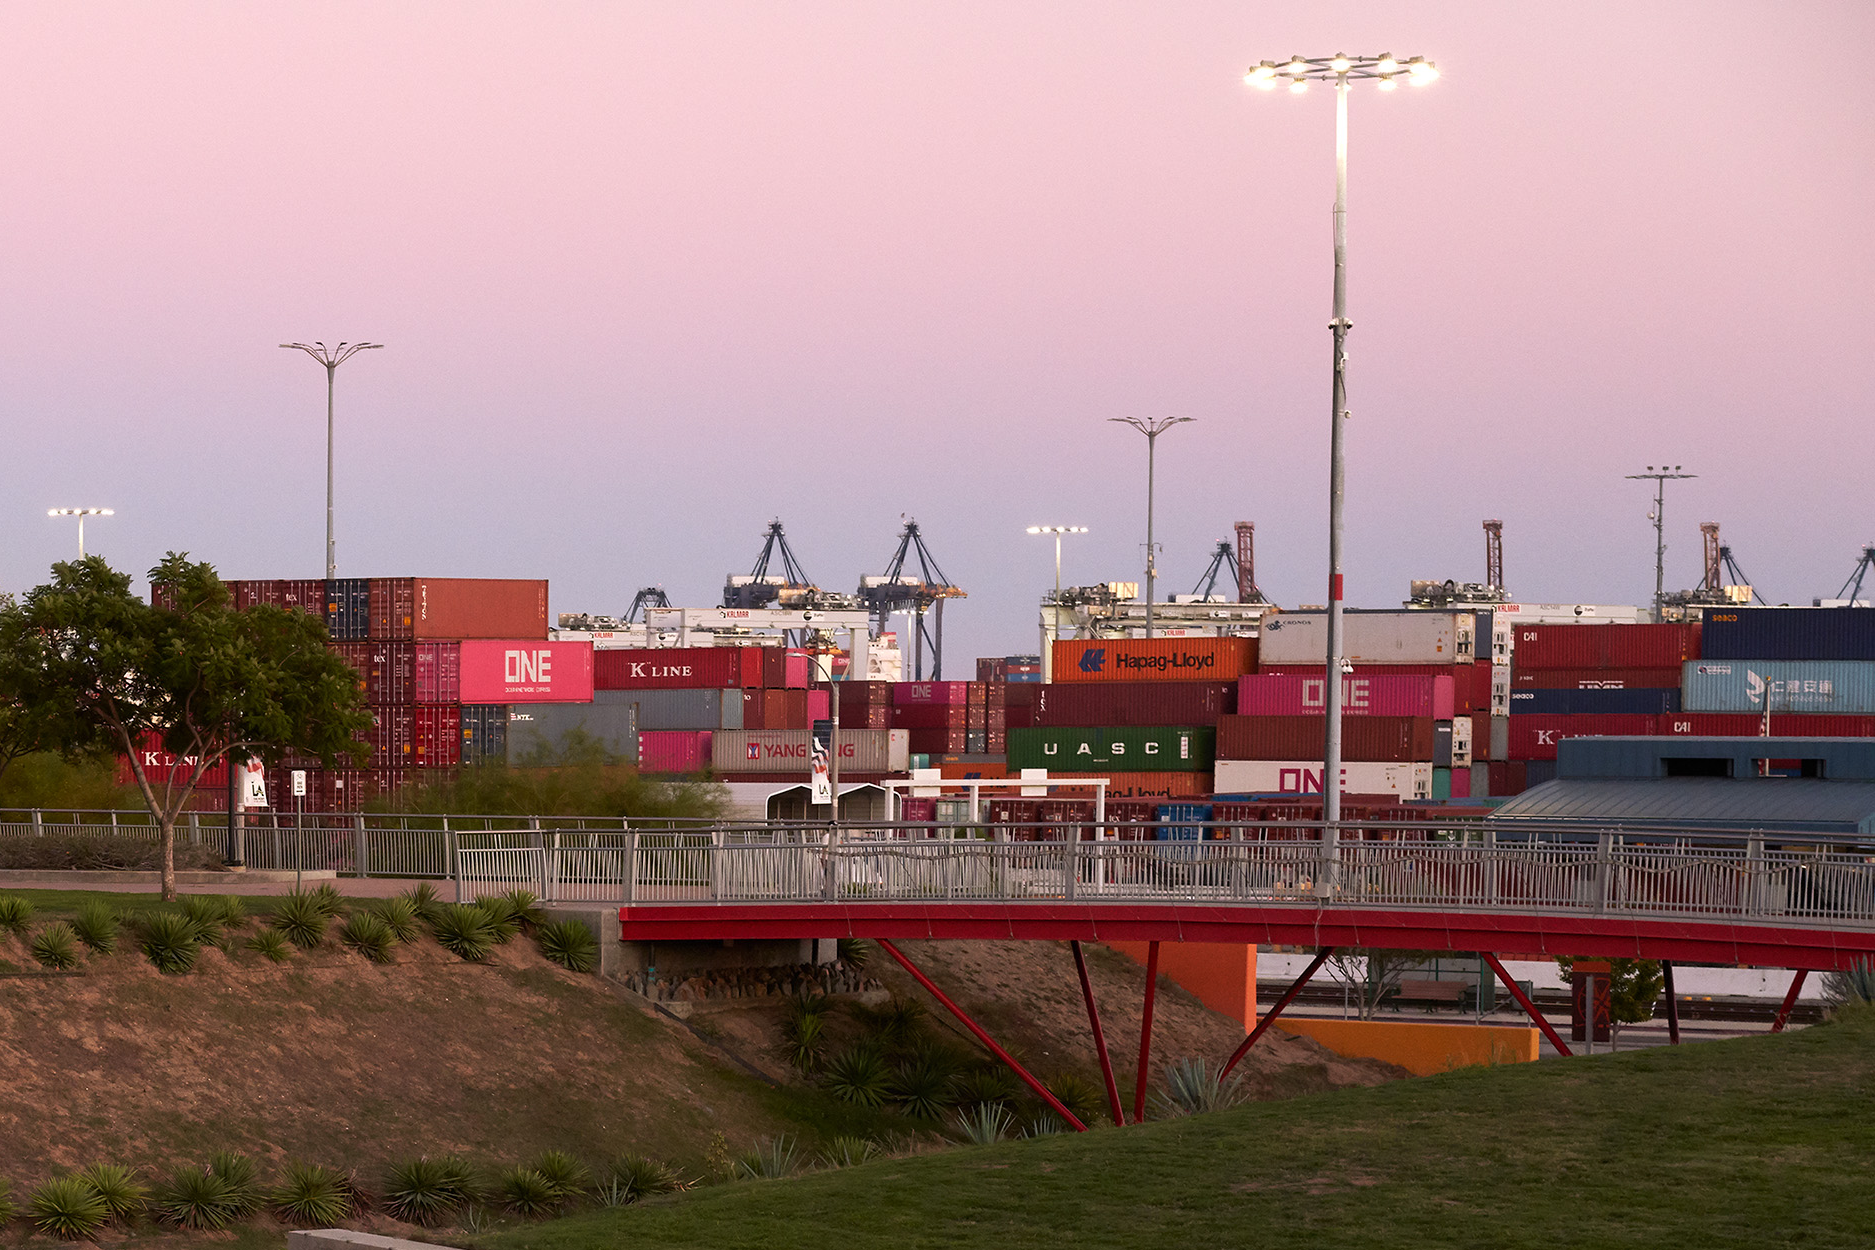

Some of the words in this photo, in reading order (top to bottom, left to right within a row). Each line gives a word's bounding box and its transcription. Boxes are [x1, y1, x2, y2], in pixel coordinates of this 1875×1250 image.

[374, 655, 385, 663] tex
[419, 653, 433, 661] ONE
[1116, 652, 1214, 671] Hapag-Lloyd
[505, 650, 551, 682] ONE
[652, 666, 693, 677] LINE
[911, 684, 932, 698] ONE
[1674, 722, 1691, 732] CAI
[764, 744, 806, 757] YANG
